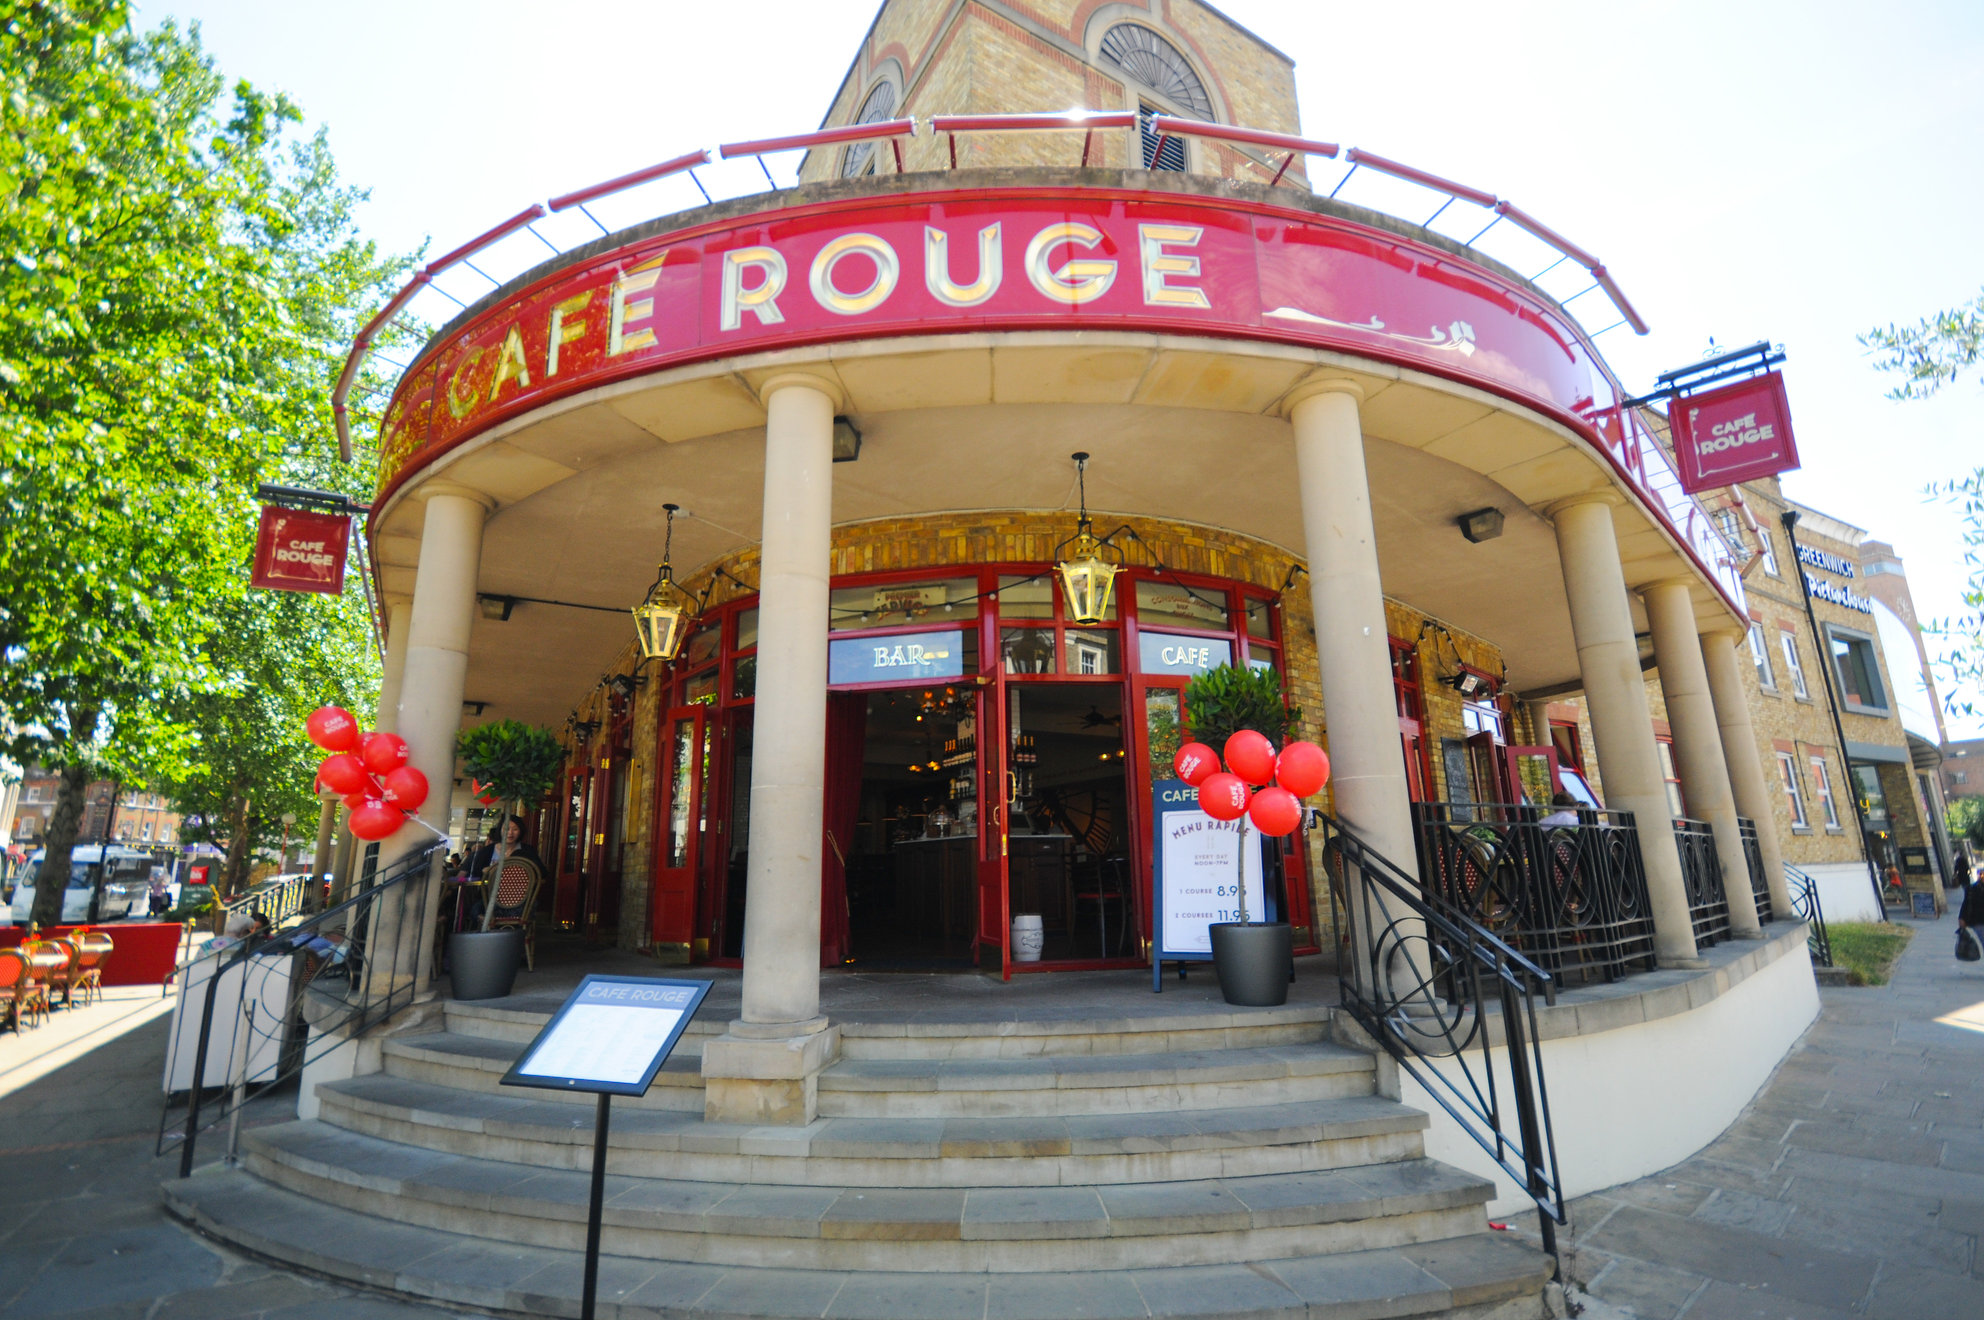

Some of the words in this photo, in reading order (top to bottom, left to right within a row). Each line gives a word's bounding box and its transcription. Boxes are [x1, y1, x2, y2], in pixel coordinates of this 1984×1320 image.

[448, 249, 669, 419] CAFÉ
[719, 220, 1212, 332] ROUGE
[1700, 424, 1775, 456] ROUGE
[276, 548, 334, 567] ROUGE
[1797, 543, 1855, 579] GREENWICH
[1804, 571, 1874, 615] Picturehous
[873, 644, 931, 668] BAR
[1172, 821, 1202, 839] MENU
[630, 989, 689, 1003] ROUGE
